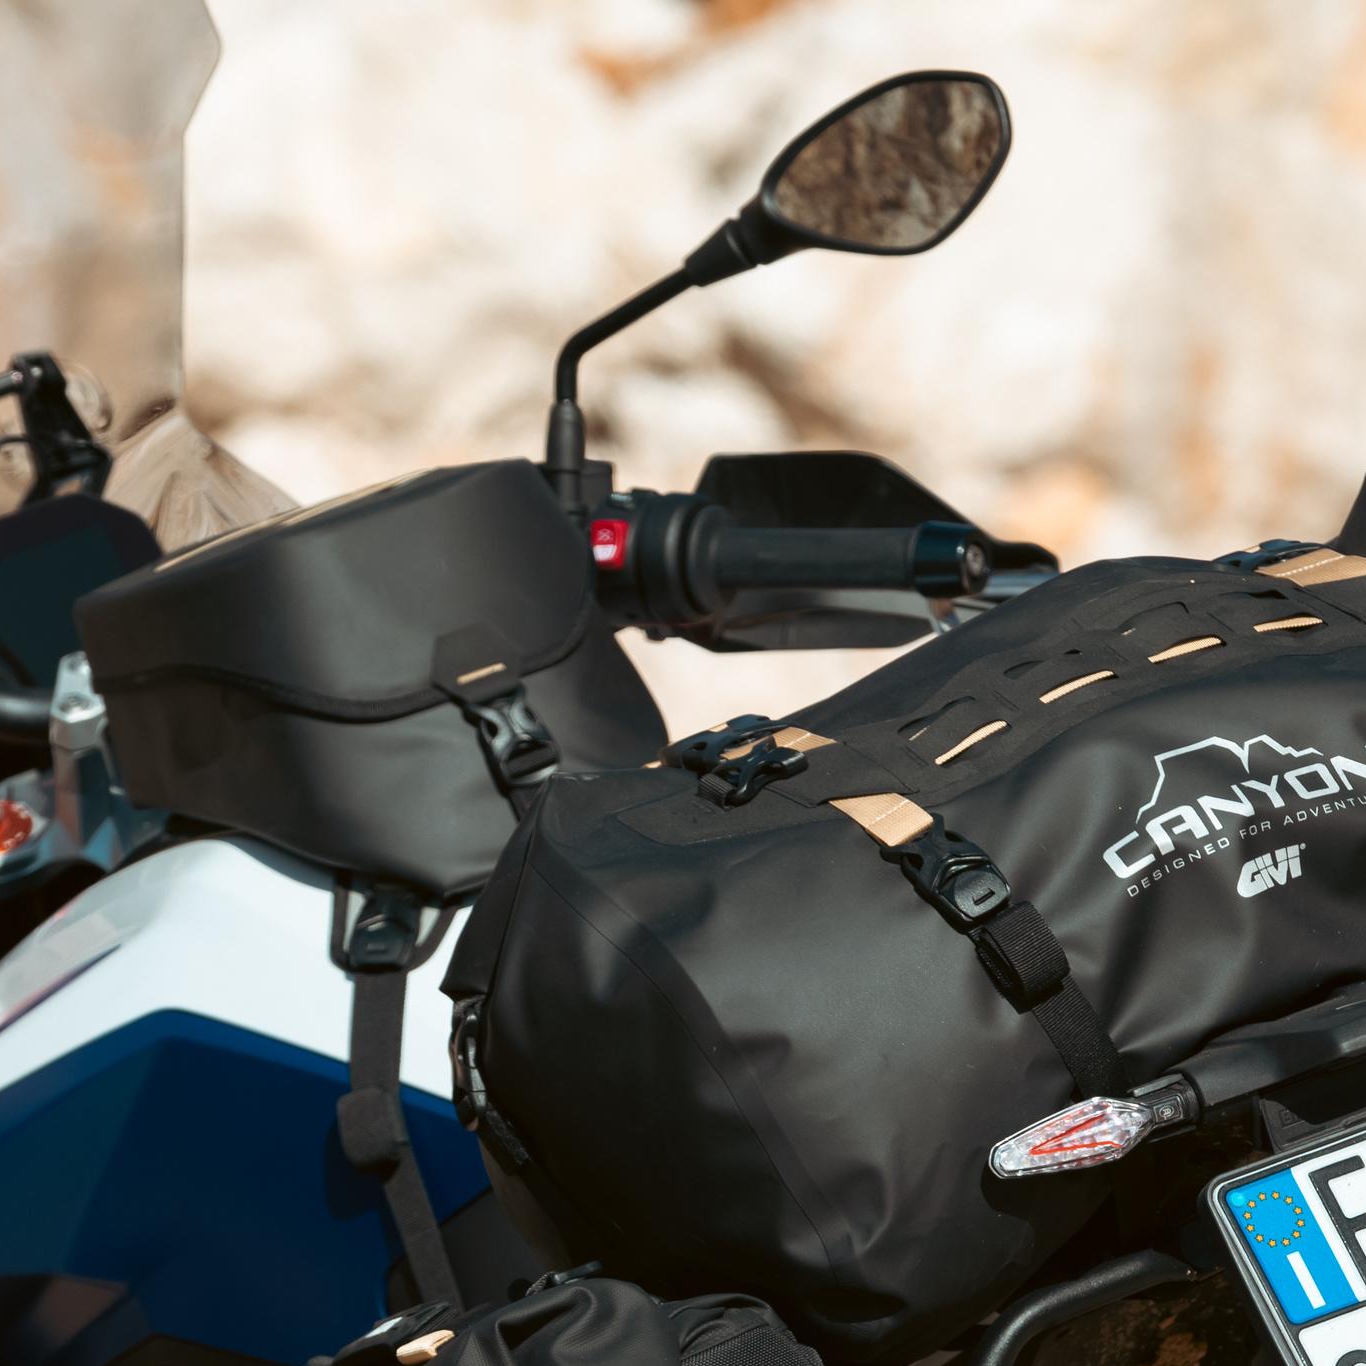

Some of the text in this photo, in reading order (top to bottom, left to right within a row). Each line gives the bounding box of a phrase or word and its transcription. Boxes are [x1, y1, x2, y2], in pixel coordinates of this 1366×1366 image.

[1126, 837, 1230, 897] DESIGNED
[1239, 820, 1272, 840] FOR
[1236, 844, 1303, 898] GIVI
